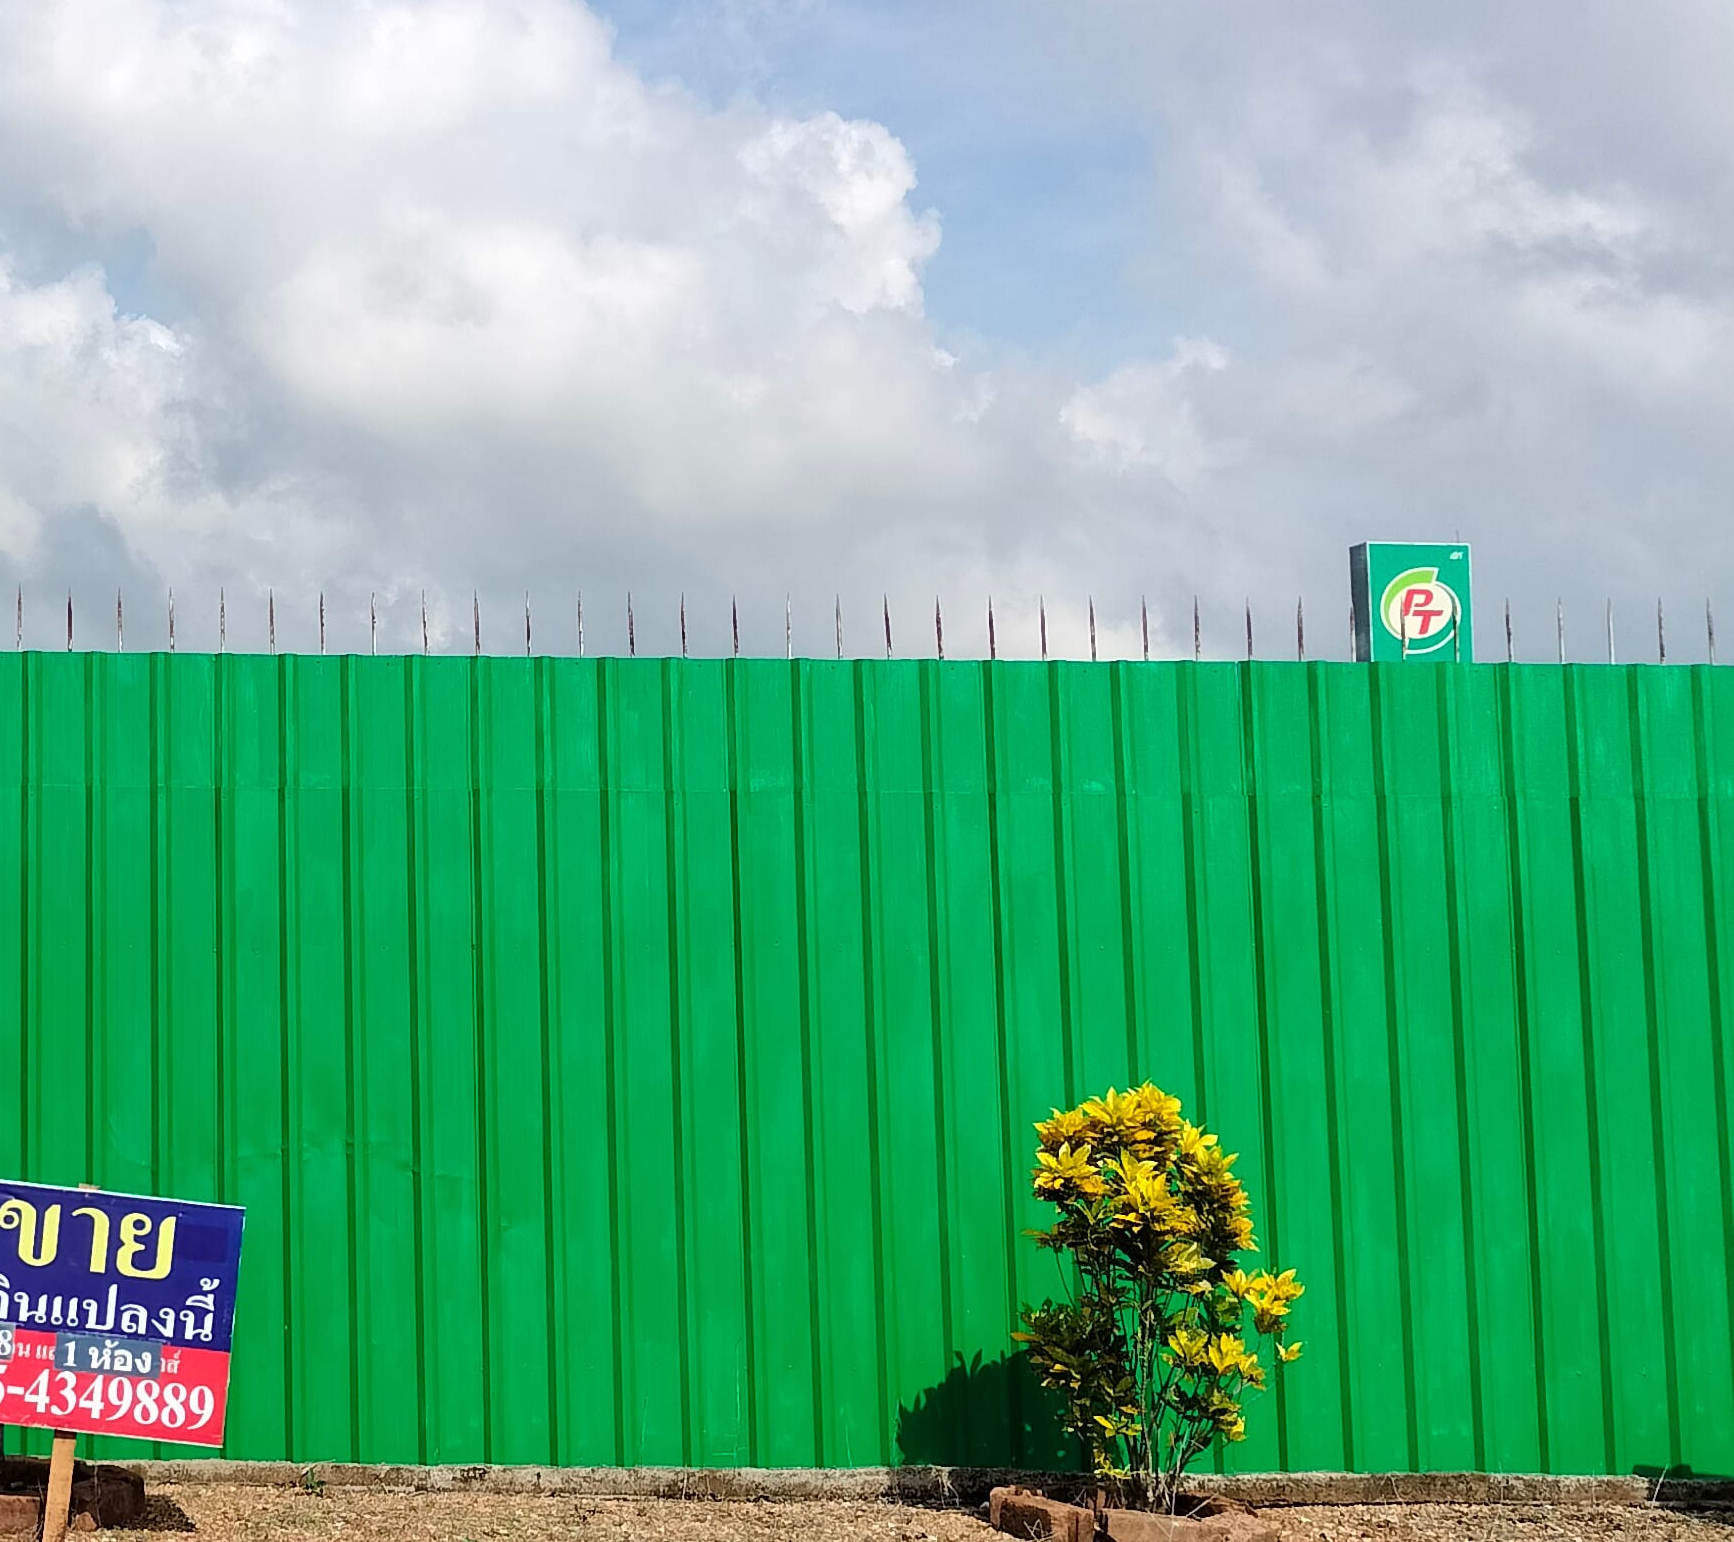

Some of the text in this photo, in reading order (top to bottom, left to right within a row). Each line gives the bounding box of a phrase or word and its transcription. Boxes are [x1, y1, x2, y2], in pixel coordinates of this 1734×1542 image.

[1403, 589, 1443, 635] PT
[63, 1341, 77, 1367] 1
[89, 1339, 152, 1374] ห้อง
